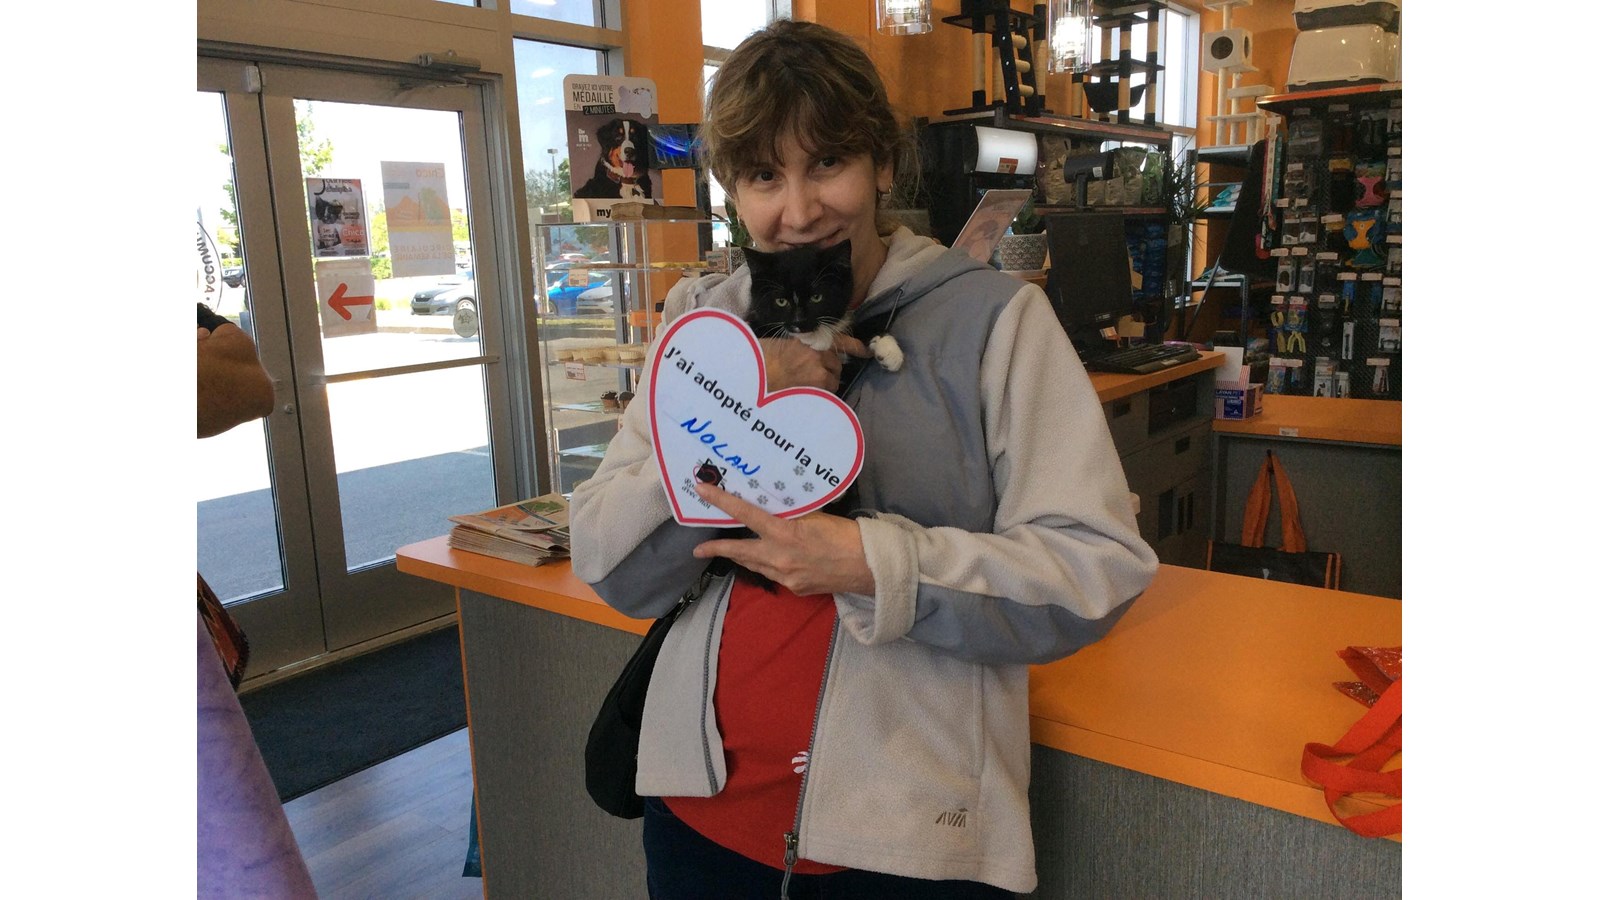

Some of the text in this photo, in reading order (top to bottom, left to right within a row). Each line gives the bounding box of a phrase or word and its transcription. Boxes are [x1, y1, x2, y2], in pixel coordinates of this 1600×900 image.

[572, 90, 614, 104] MÉDAILLE
[591, 105, 615, 114] MINUTES
[664, 346, 840, 487] J'ai adopté pour la vie
[680, 417, 761, 476] NOLAN
